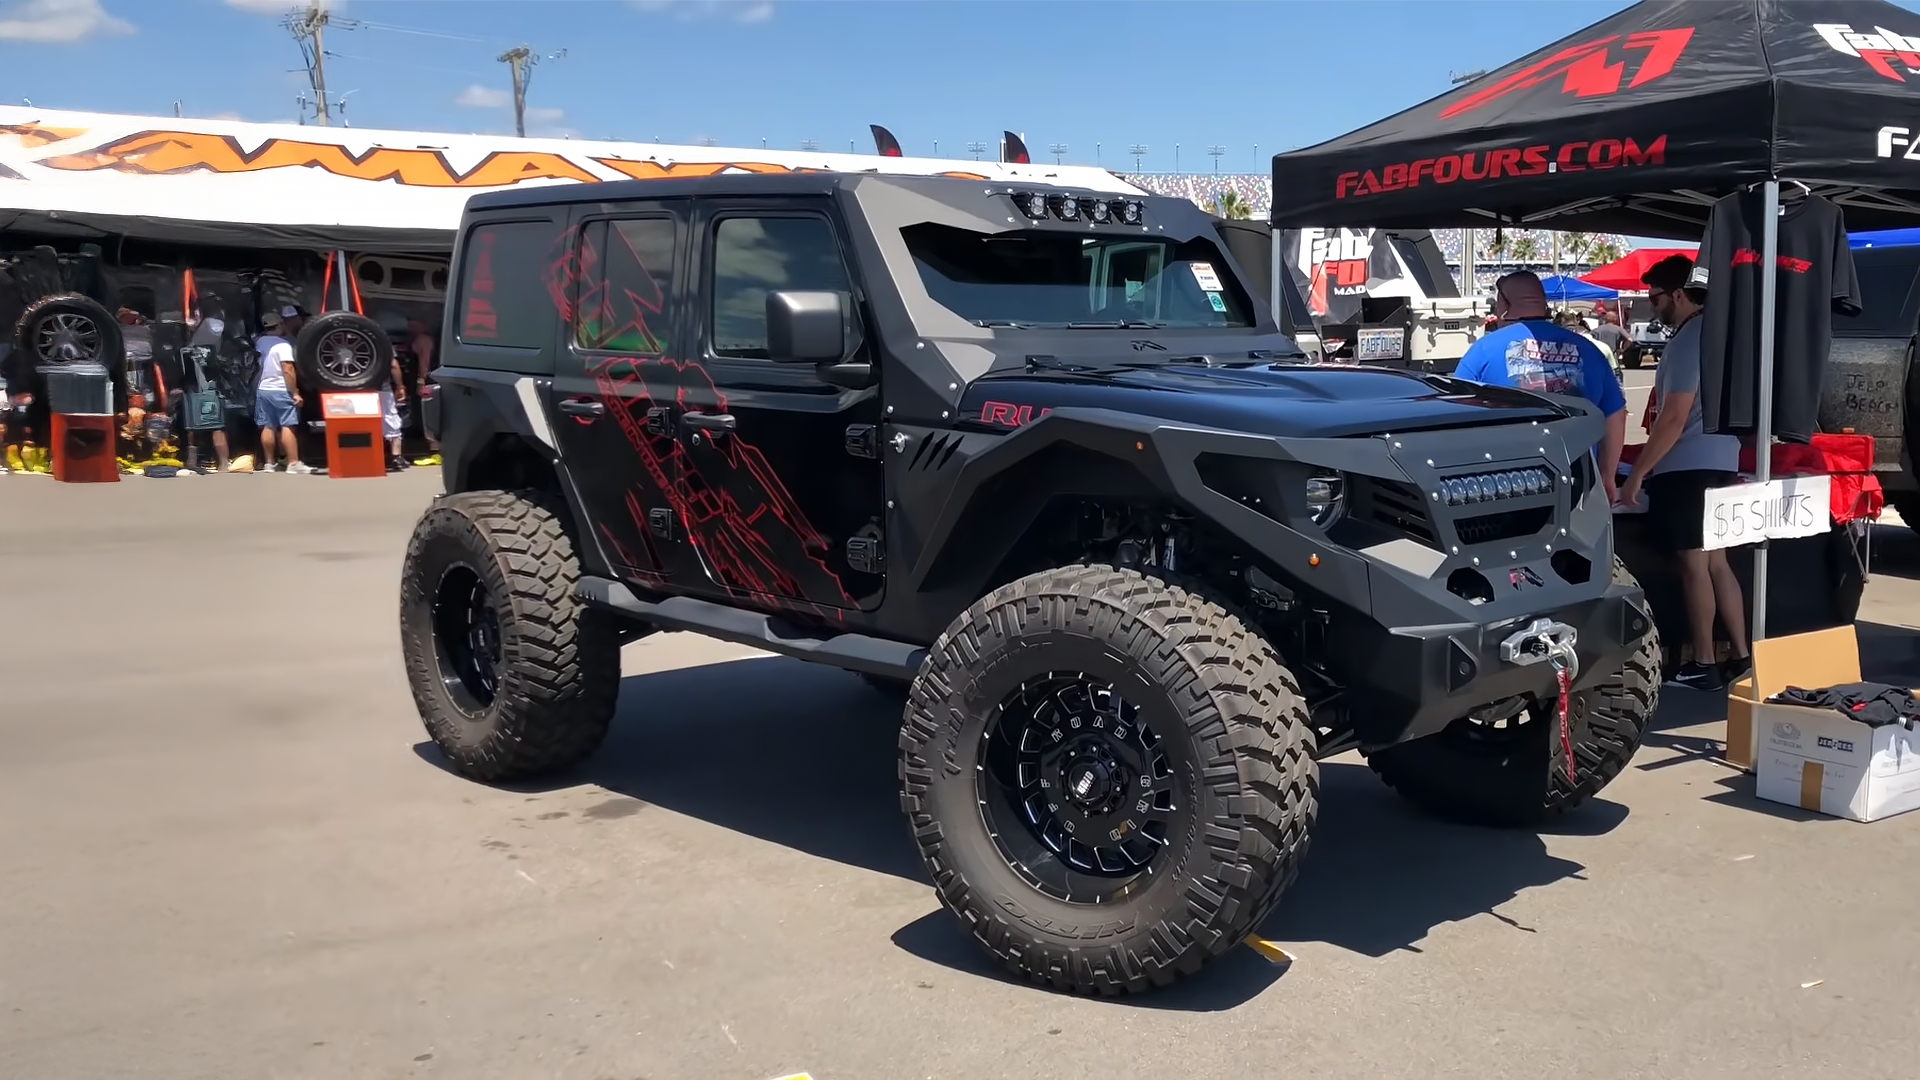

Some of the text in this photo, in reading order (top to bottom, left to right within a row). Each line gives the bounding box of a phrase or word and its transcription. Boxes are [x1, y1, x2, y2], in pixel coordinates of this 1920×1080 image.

[1335, 134, 1668, 199] FABFOURS.COM
[1360, 337, 1401, 352] FABFOURS
[981, 400, 1053, 427] RU
[1714, 494, 1814, 541] $5 SHIRTS
